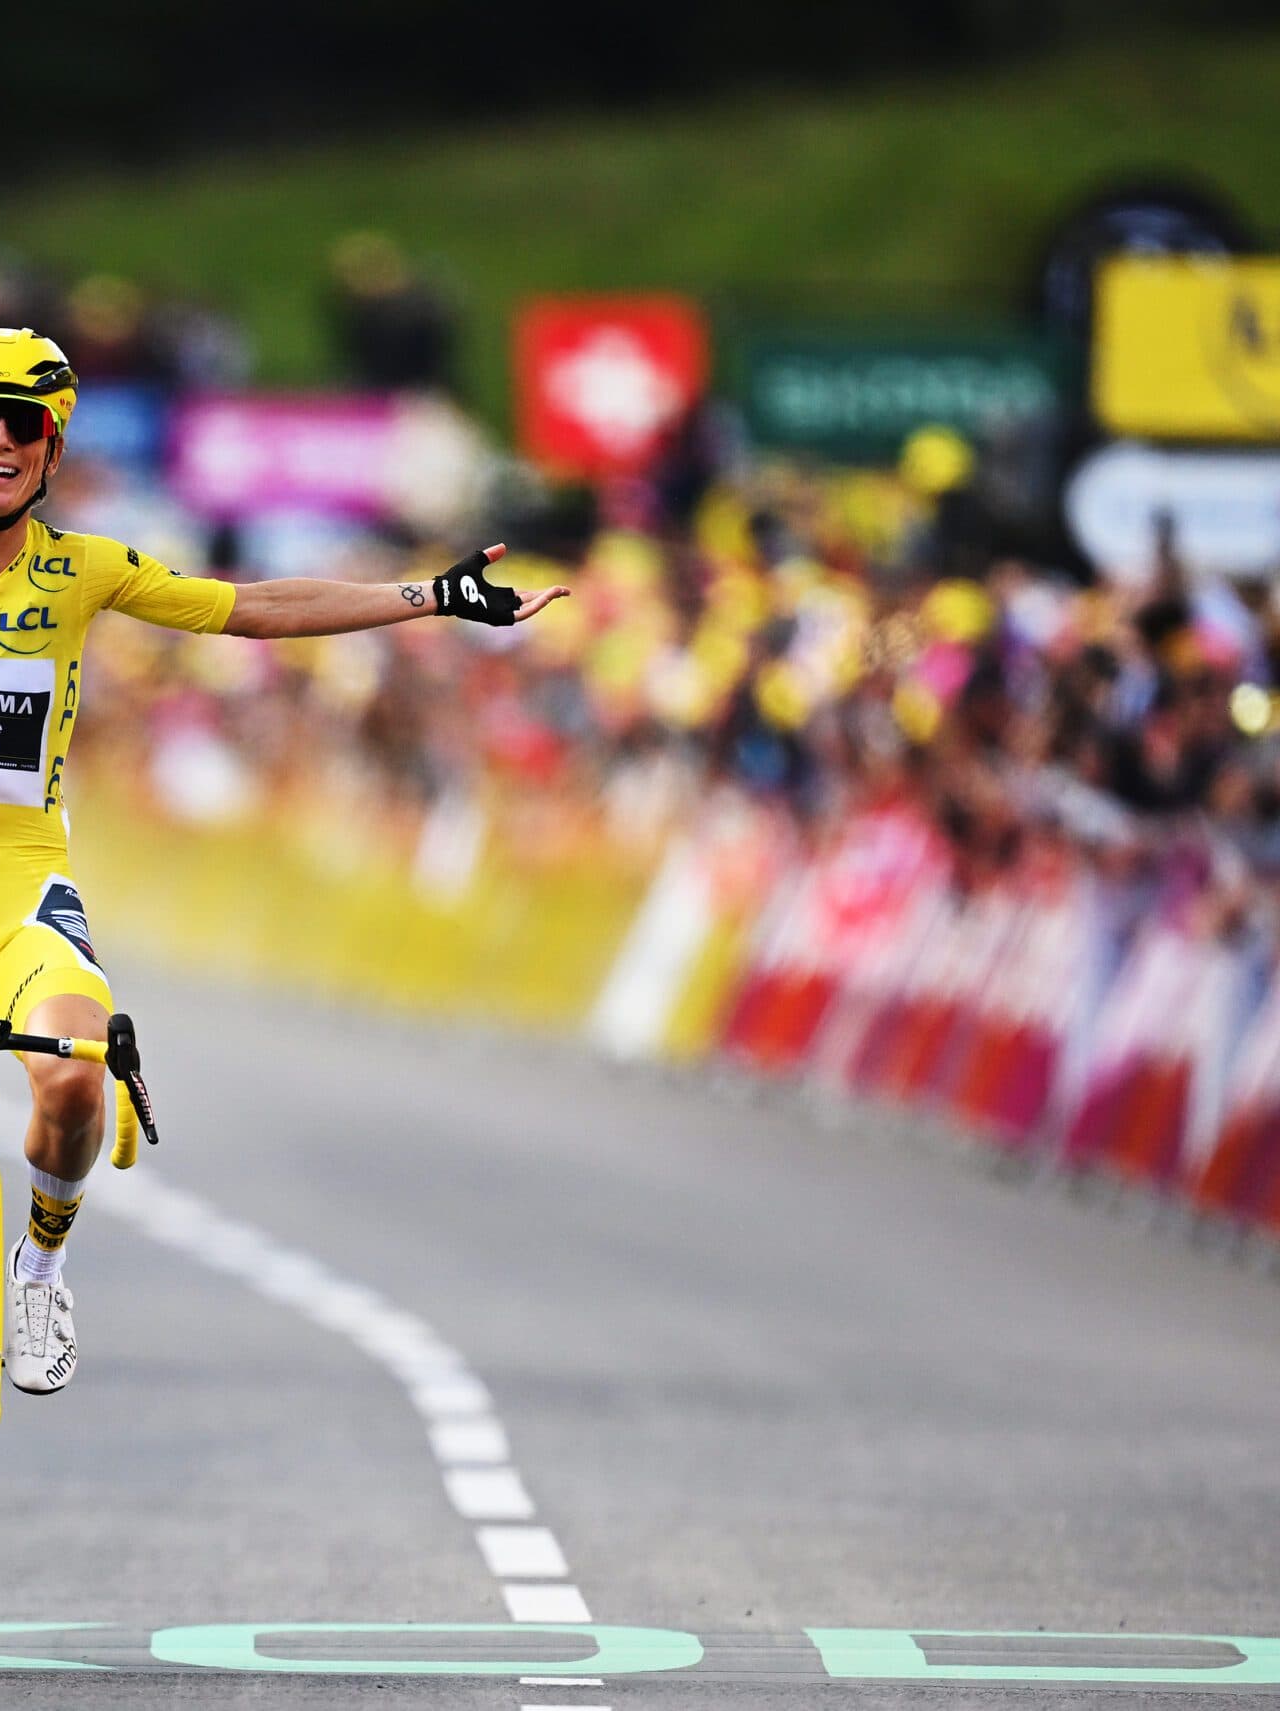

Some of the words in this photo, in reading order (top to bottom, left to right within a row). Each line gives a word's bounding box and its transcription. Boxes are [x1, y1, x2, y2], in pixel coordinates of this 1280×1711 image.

[33, 555, 77, 578] LCL
[60, 660, 78, 732] LCL
[44, 756, 64, 814] LCL
[6, 961, 45, 1021] antini
